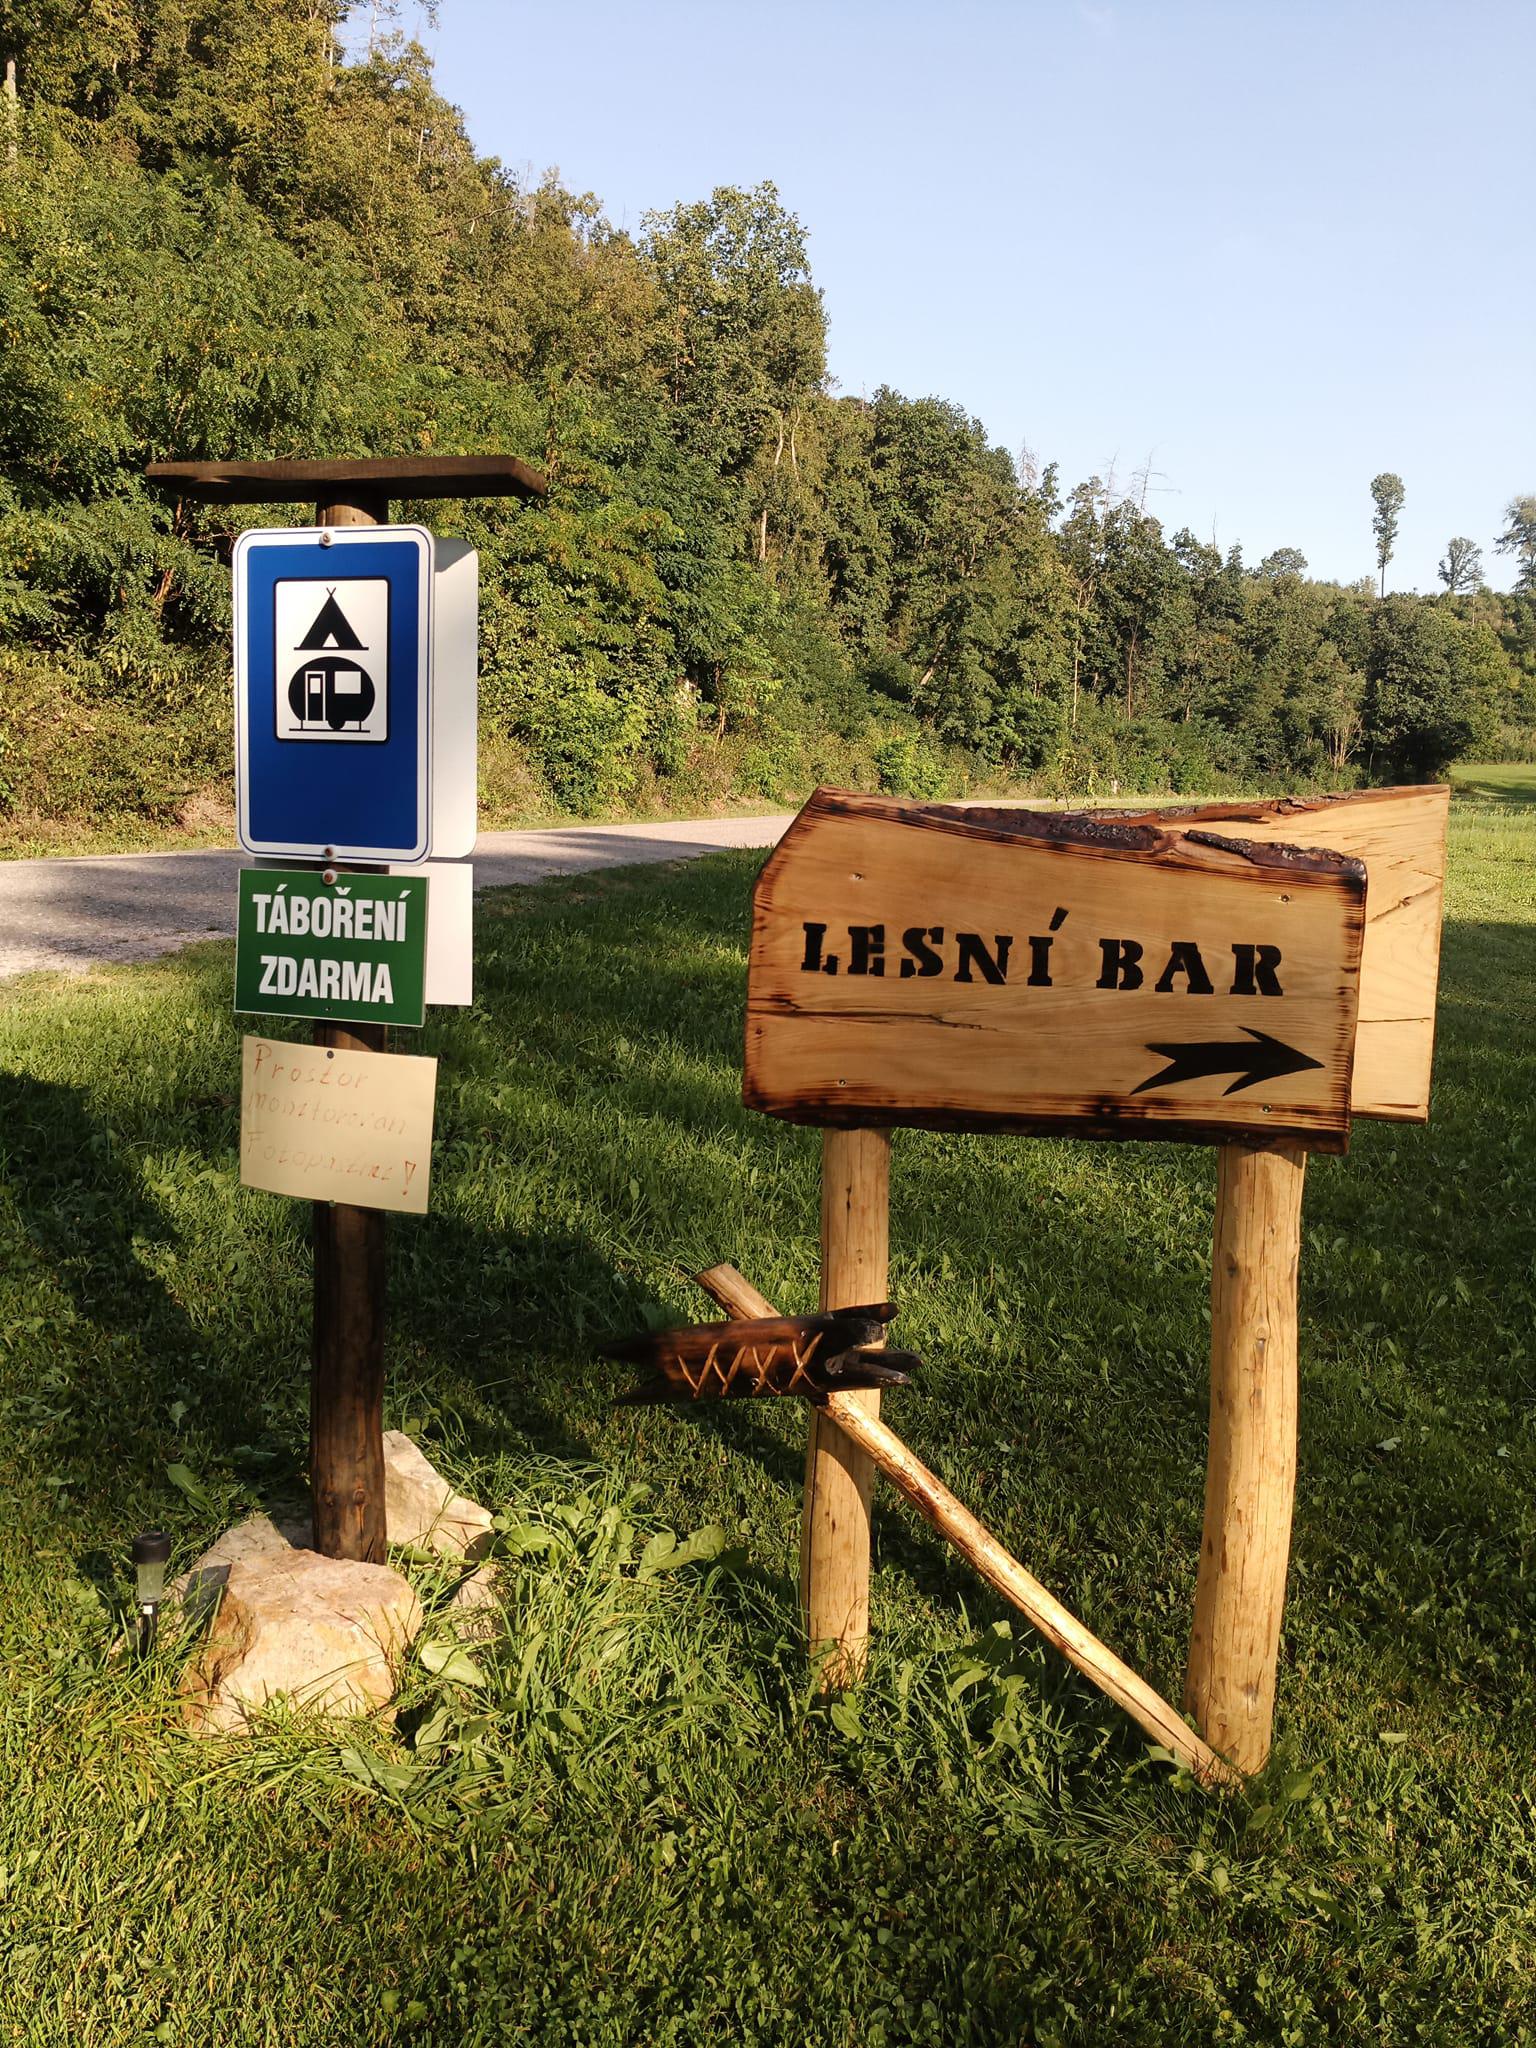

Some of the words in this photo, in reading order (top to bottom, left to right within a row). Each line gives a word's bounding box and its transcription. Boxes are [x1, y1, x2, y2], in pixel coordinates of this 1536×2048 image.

[252, 884, 412, 942] TÁBOŘENÍ
[800, 906, 1069, 987] LESNÍ
[1096, 938, 1285, 997] BAR
[258, 955, 394, 1004] ZDARMA
[254, 1043, 369, 1089] Prostor
